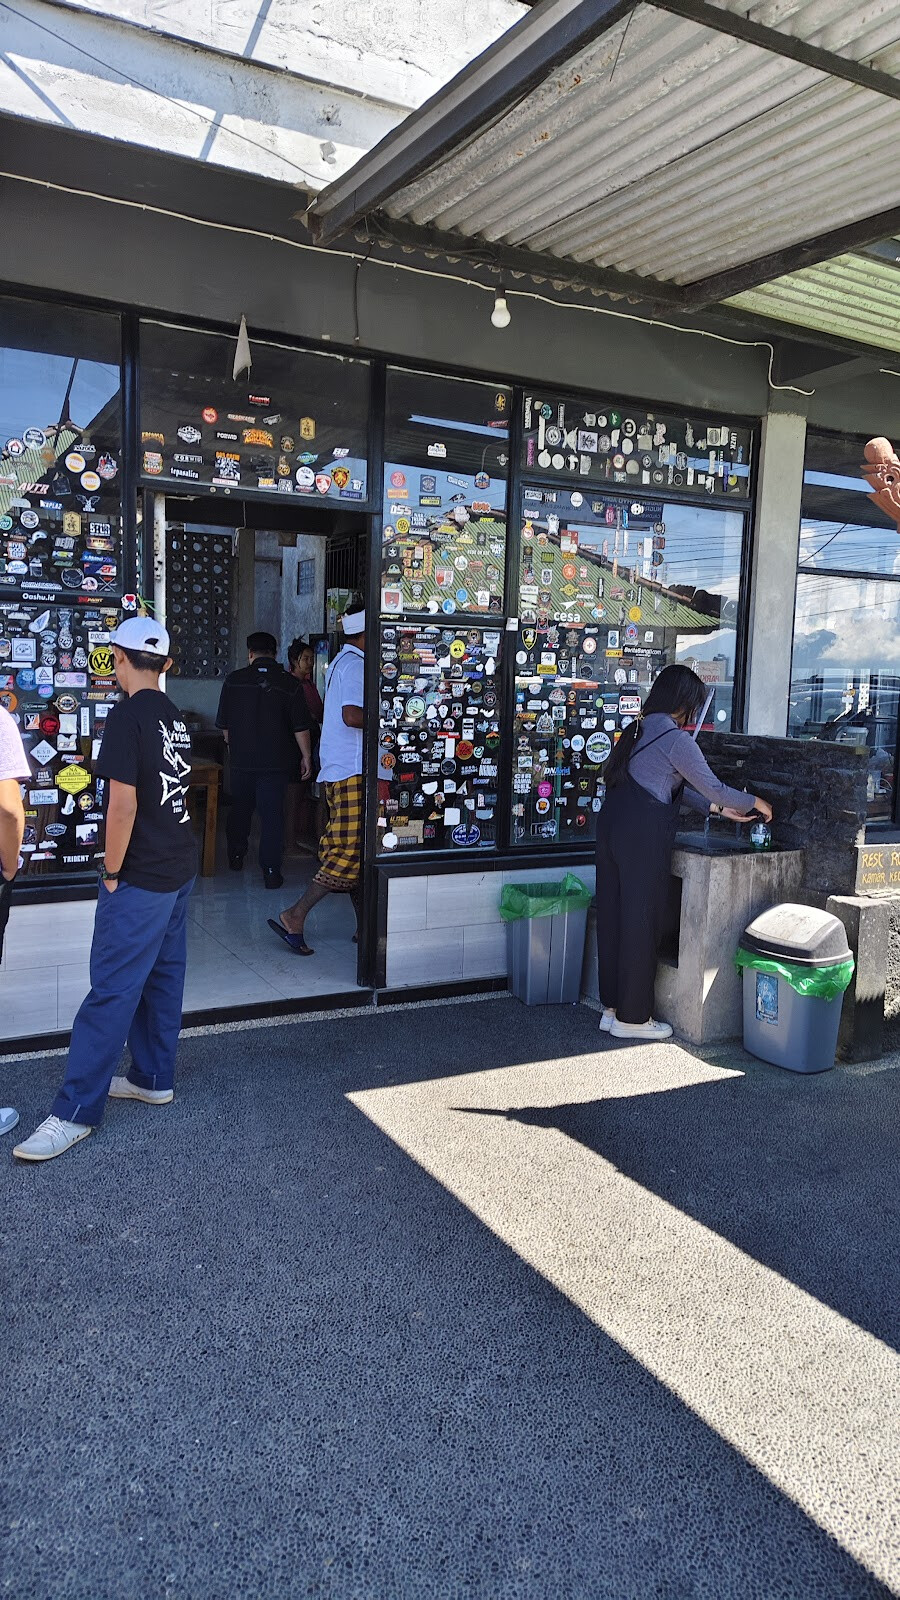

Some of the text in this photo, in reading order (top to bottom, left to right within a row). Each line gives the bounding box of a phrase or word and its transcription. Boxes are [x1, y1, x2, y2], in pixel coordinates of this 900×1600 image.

[22, 593, 55, 602] Oashu.id
[553, 612, 581, 622] cesa
[862, 853, 883, 868] REST
